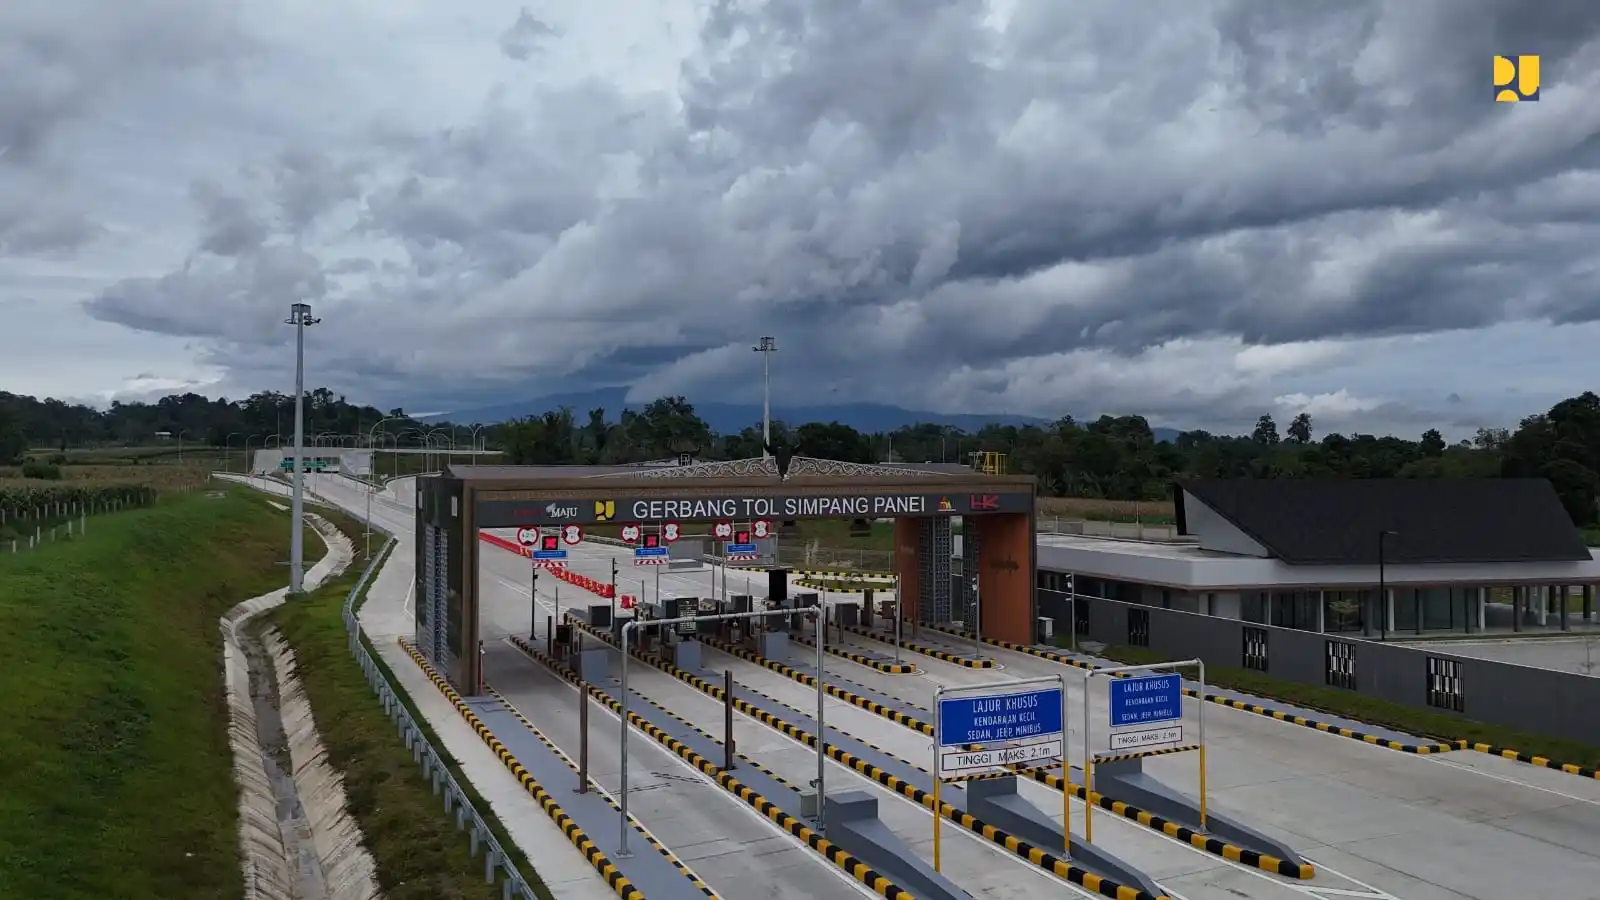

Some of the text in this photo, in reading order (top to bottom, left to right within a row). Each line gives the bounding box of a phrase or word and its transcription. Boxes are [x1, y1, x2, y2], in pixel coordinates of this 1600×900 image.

[551, 507, 578, 519] MAJU
[632, 496, 925, 519] GERBANG TOL SIMPANG PANEI
[1123, 679, 1170, 693] LAJUR KHUSUS
[972, 695, 1038, 713] LAJUR KHUSUS
[1125, 695, 1168, 706] KENDARAAN KECIL
[973, 711, 1035, 727] KENDARAAN KECIL
[967, 729, 993, 741] SEDAN,
[1015, 722, 1041, 736] MINIBUS
[1118, 735, 1139, 744] TINGGI
[956, 753, 992, 766] TINGGI
[1031, 746, 1051, 758] 2.1m
